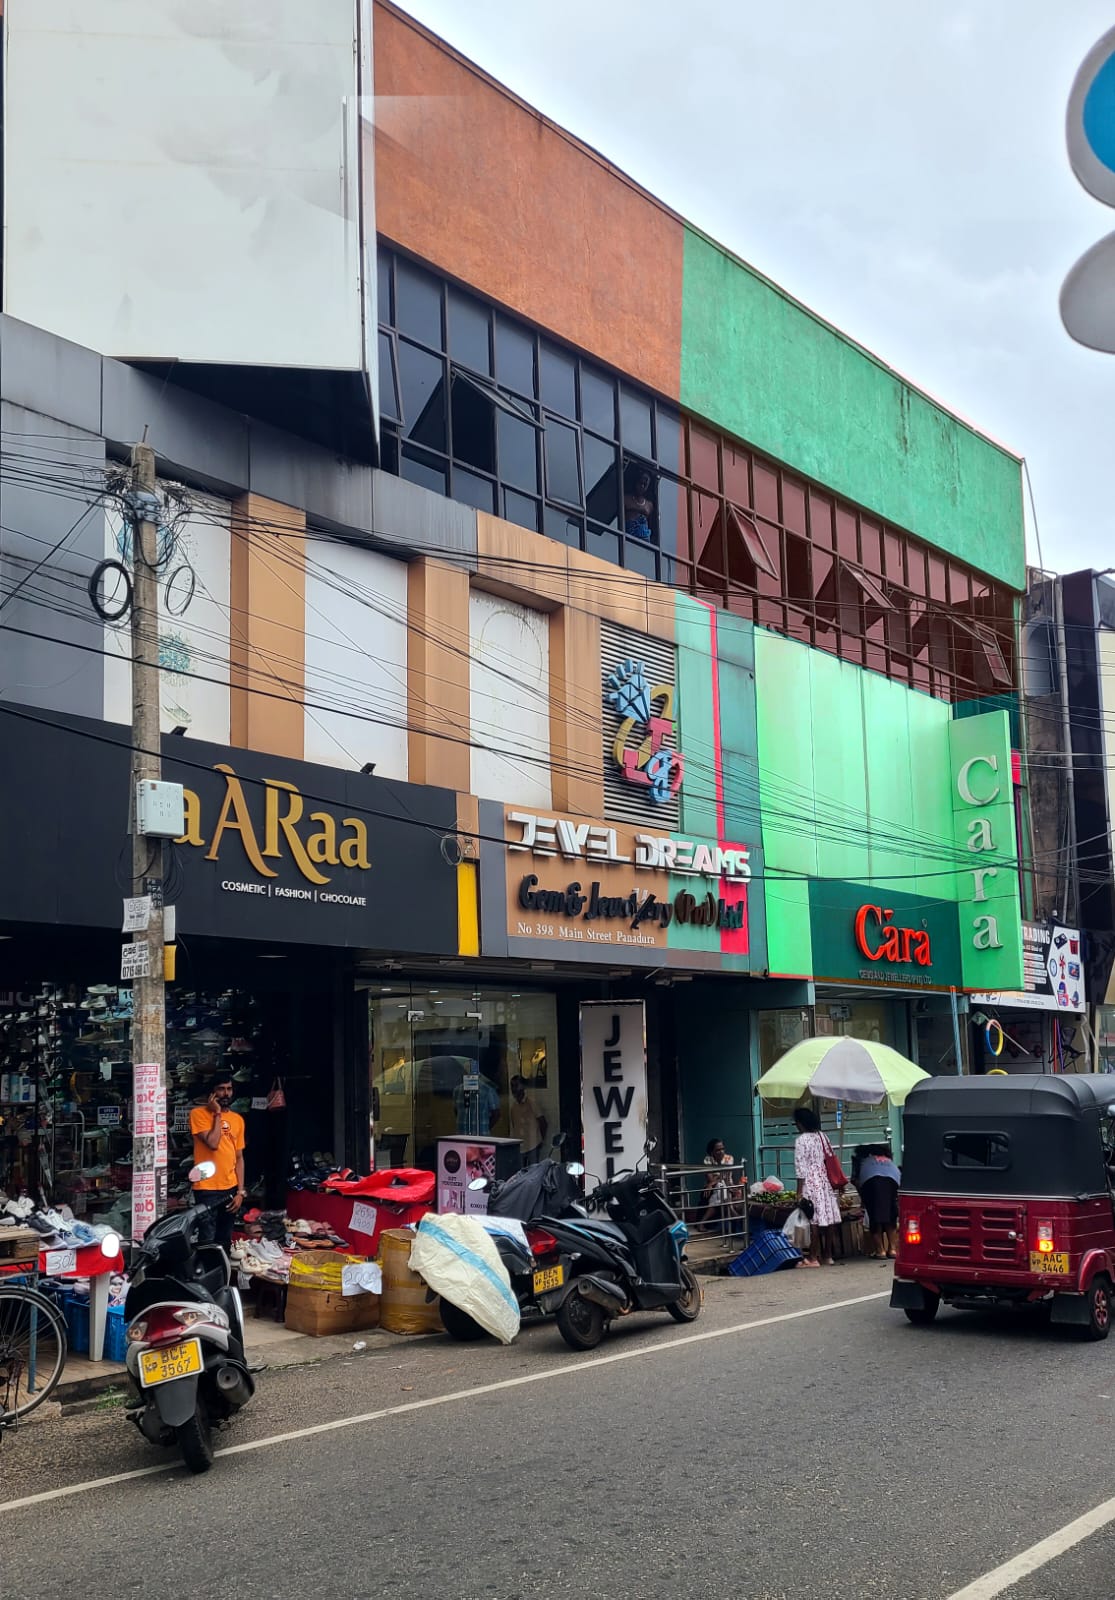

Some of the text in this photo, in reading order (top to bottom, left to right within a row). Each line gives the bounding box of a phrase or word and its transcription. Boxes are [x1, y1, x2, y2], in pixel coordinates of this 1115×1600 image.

[507, 811, 752, 883] JEWEL DREAMS
[222, 880, 367, 907] COSMETIC FASHION CHOCOLATE
[519, 874, 566, 911] Gem
[566, 882, 588, 917] &
[717, 898, 745, 929] Ltd
[518, 922, 656, 945] No 398 Main Street Panadura
[855, 904, 933, 966] Cara
[1042, 1263, 1064, 1273] 3446
[1043, 1253, 1063, 1263] AAC
[160, 1356, 192, 1378] 3567
